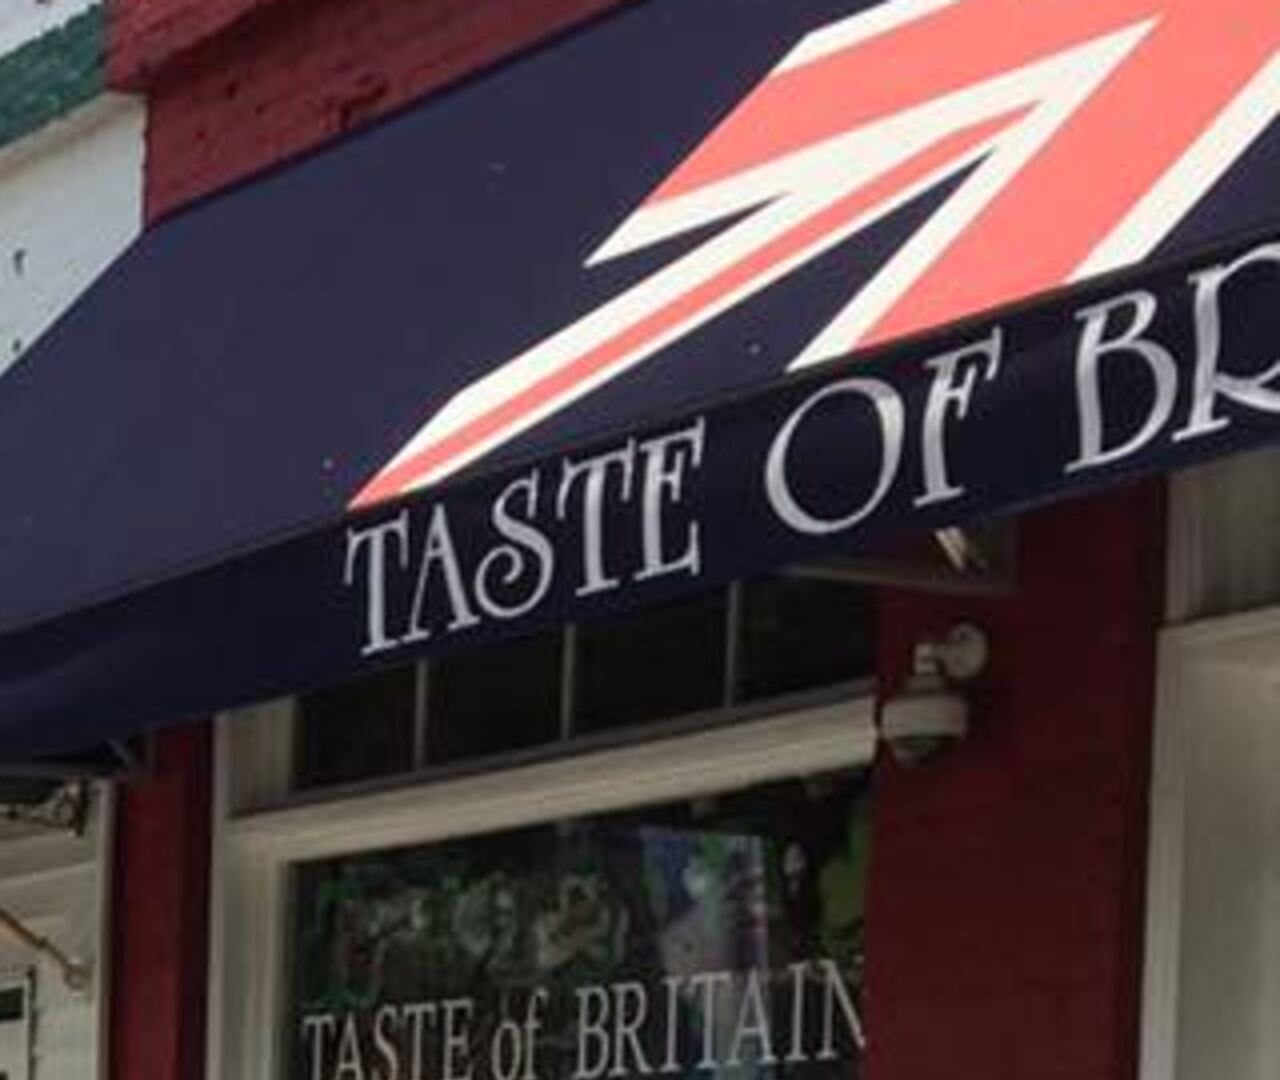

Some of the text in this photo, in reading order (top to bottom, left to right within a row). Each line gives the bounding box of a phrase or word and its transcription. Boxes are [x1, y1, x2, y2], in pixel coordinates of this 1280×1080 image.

[343, 417, 707, 656] TASTE
[763, 326, 1003, 535] OF
[572, 957, 866, 1080] BRITAIN
